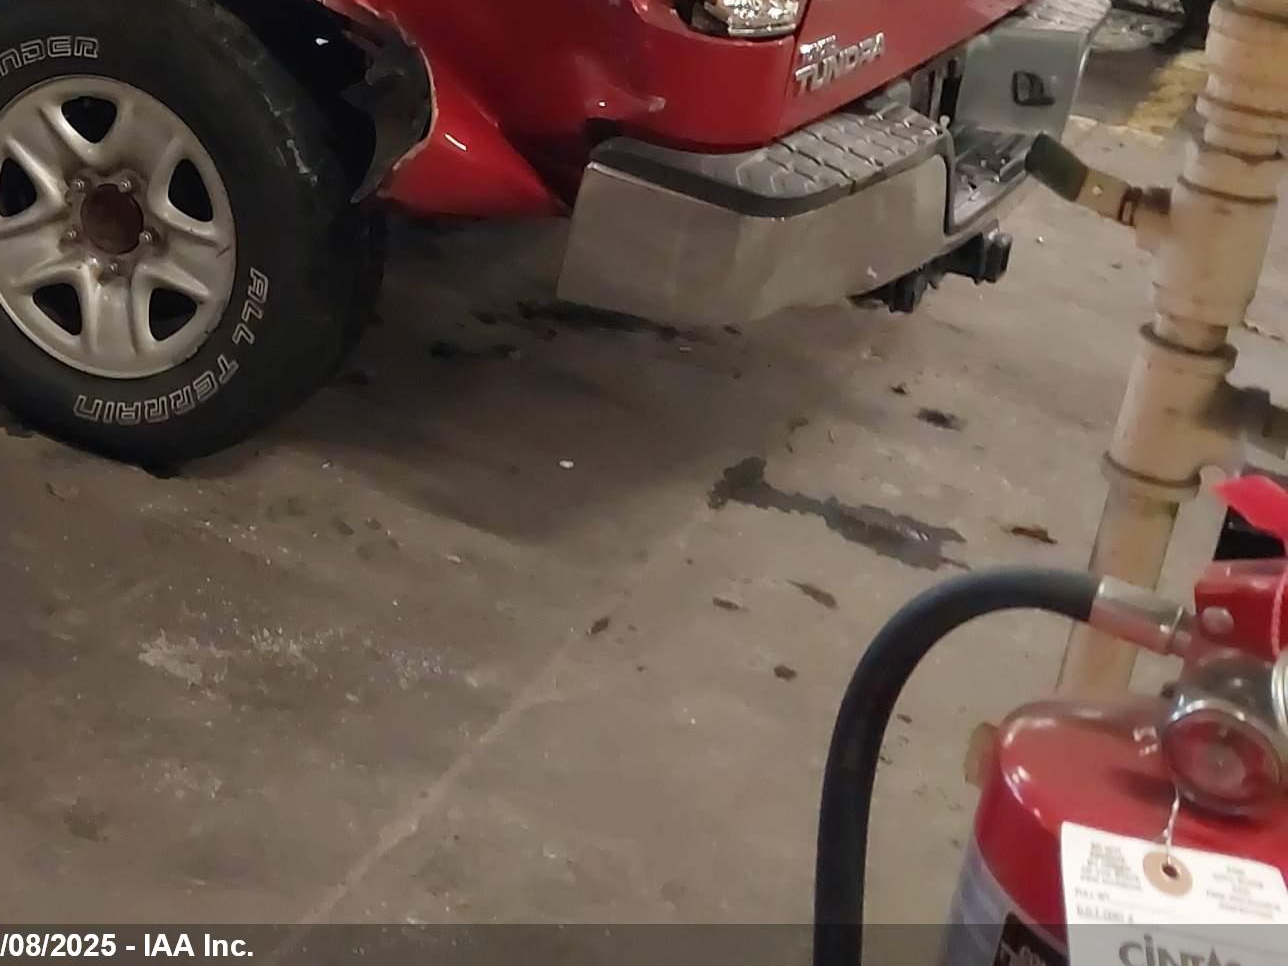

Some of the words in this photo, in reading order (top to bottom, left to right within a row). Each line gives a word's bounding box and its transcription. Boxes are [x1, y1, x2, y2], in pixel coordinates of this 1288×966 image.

[795, 32, 885, 94] TUNDRA
[232, 268, 269, 345] ALL
[74, 354, 239, 424] TERRAIN
